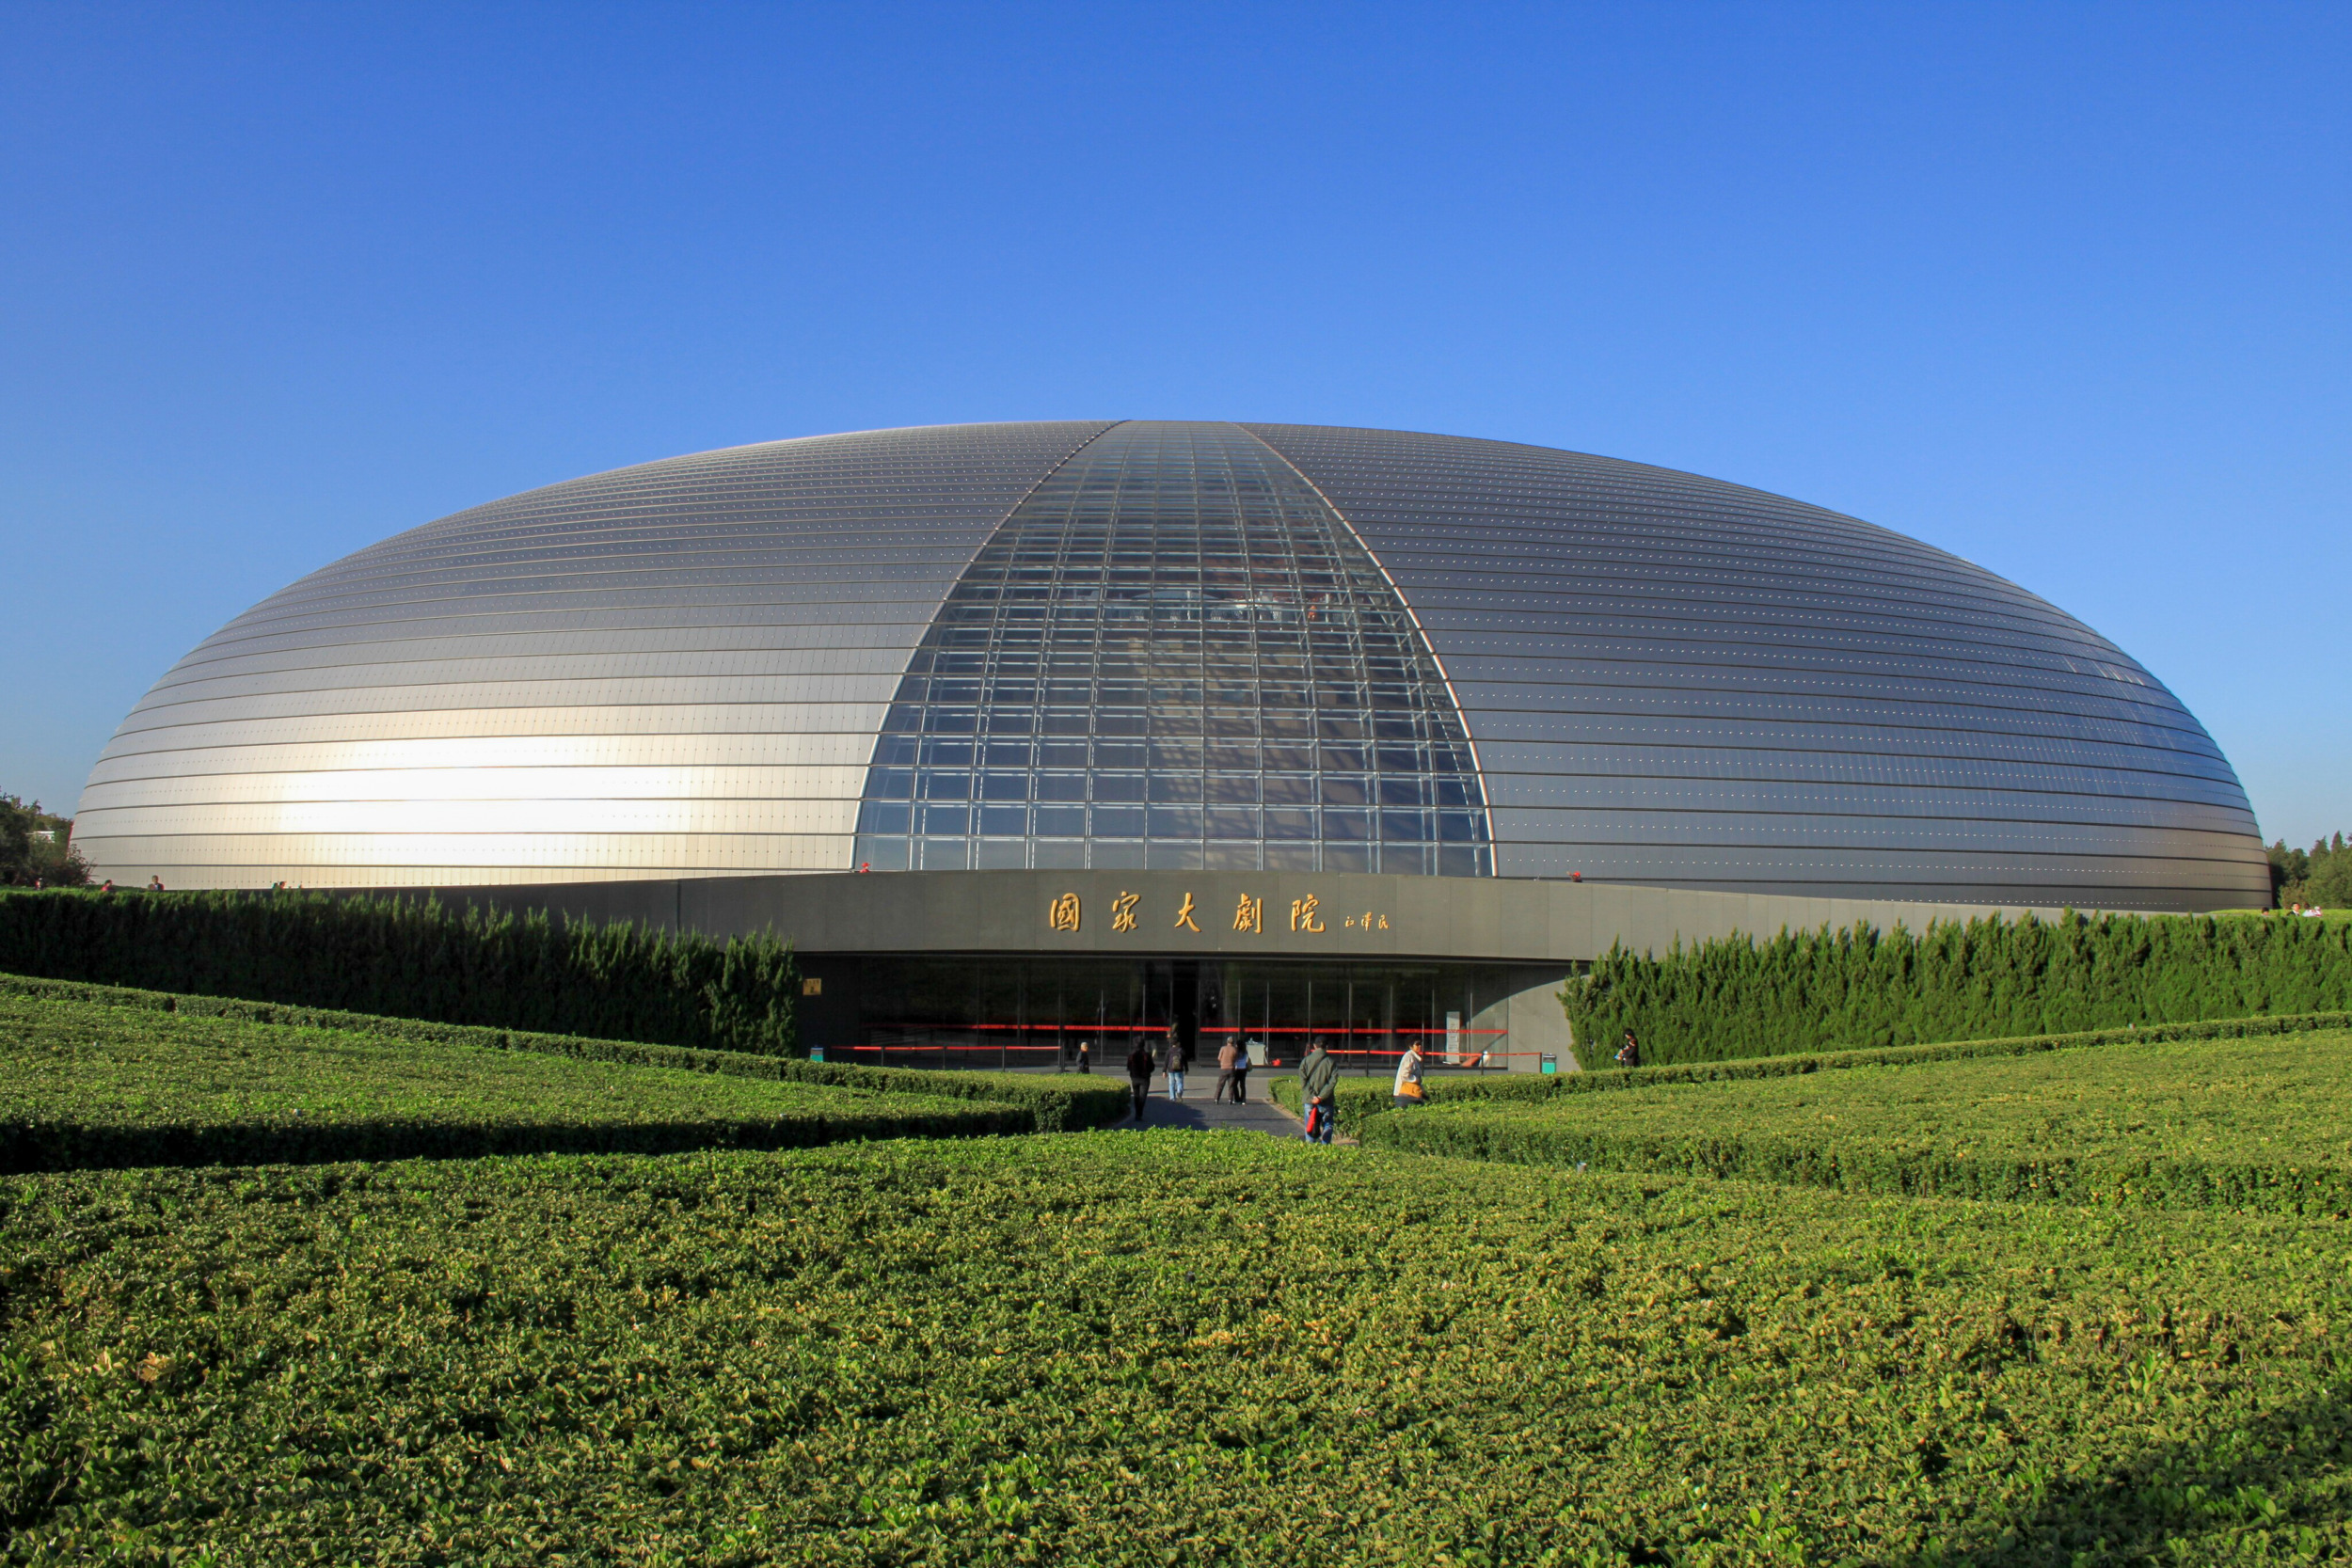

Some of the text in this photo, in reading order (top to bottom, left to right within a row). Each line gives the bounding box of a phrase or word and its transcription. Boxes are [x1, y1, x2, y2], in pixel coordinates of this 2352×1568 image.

[1049, 891, 1326, 934] 國家大劇院
